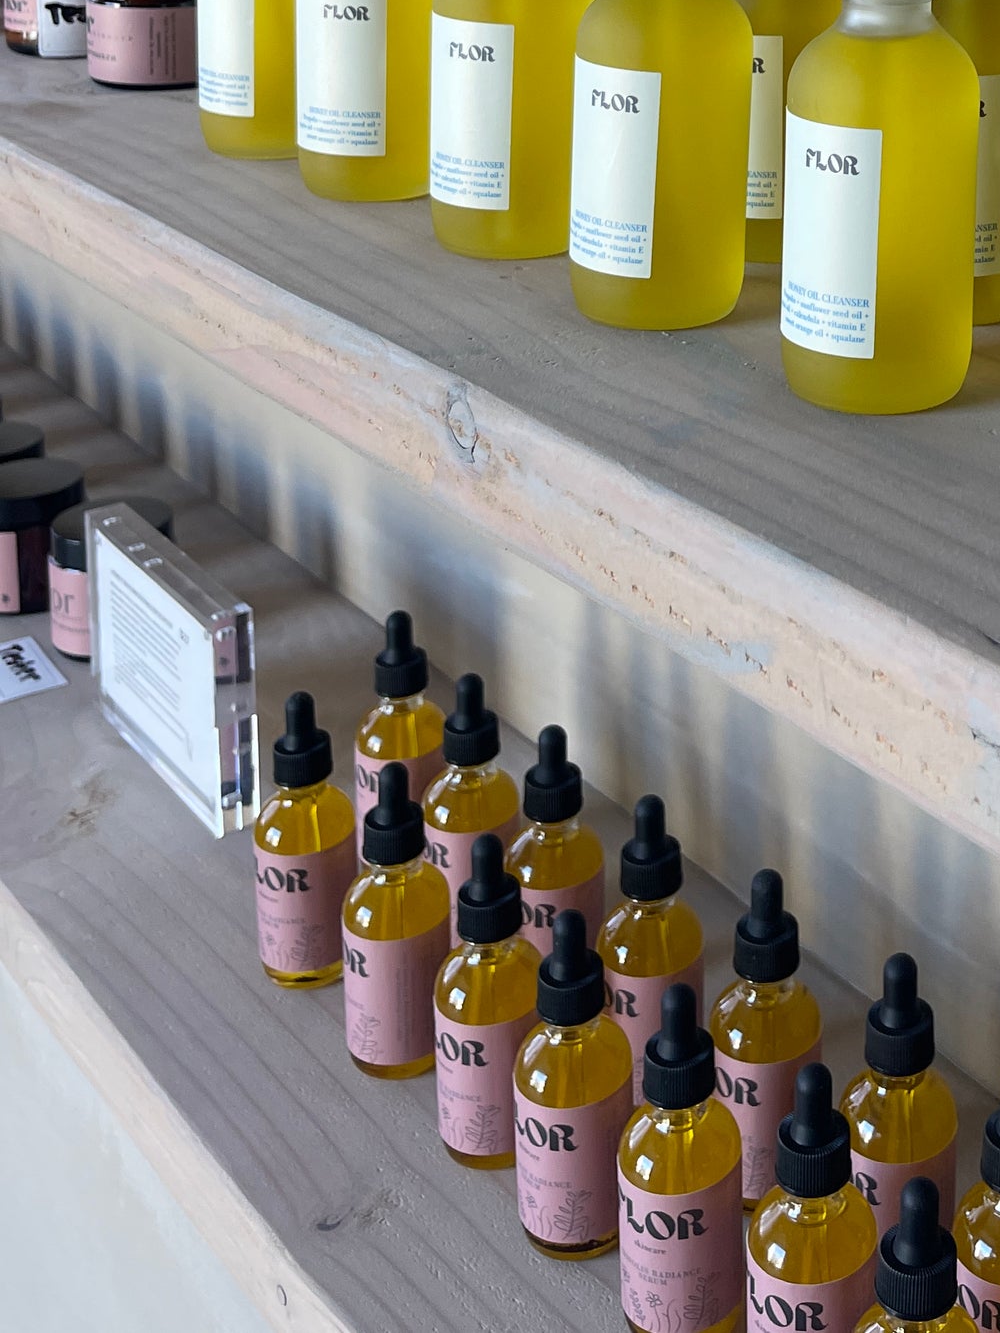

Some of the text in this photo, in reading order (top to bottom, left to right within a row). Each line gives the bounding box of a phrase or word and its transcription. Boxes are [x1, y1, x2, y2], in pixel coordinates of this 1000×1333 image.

[323, 4, 370, 21] FLOR
[450, 41, 495, 63] FLOR
[591, 89, 640, 114] FLOR
[805, 148, 860, 176] FLOR
[604, 219, 647, 233] CLEANSER
[822, 294, 870, 308] CLEANSER
[851, 311, 862, 319] oil
[436, 1032, 490, 1067] OR
[747, 1270, 829, 1332] LOR
